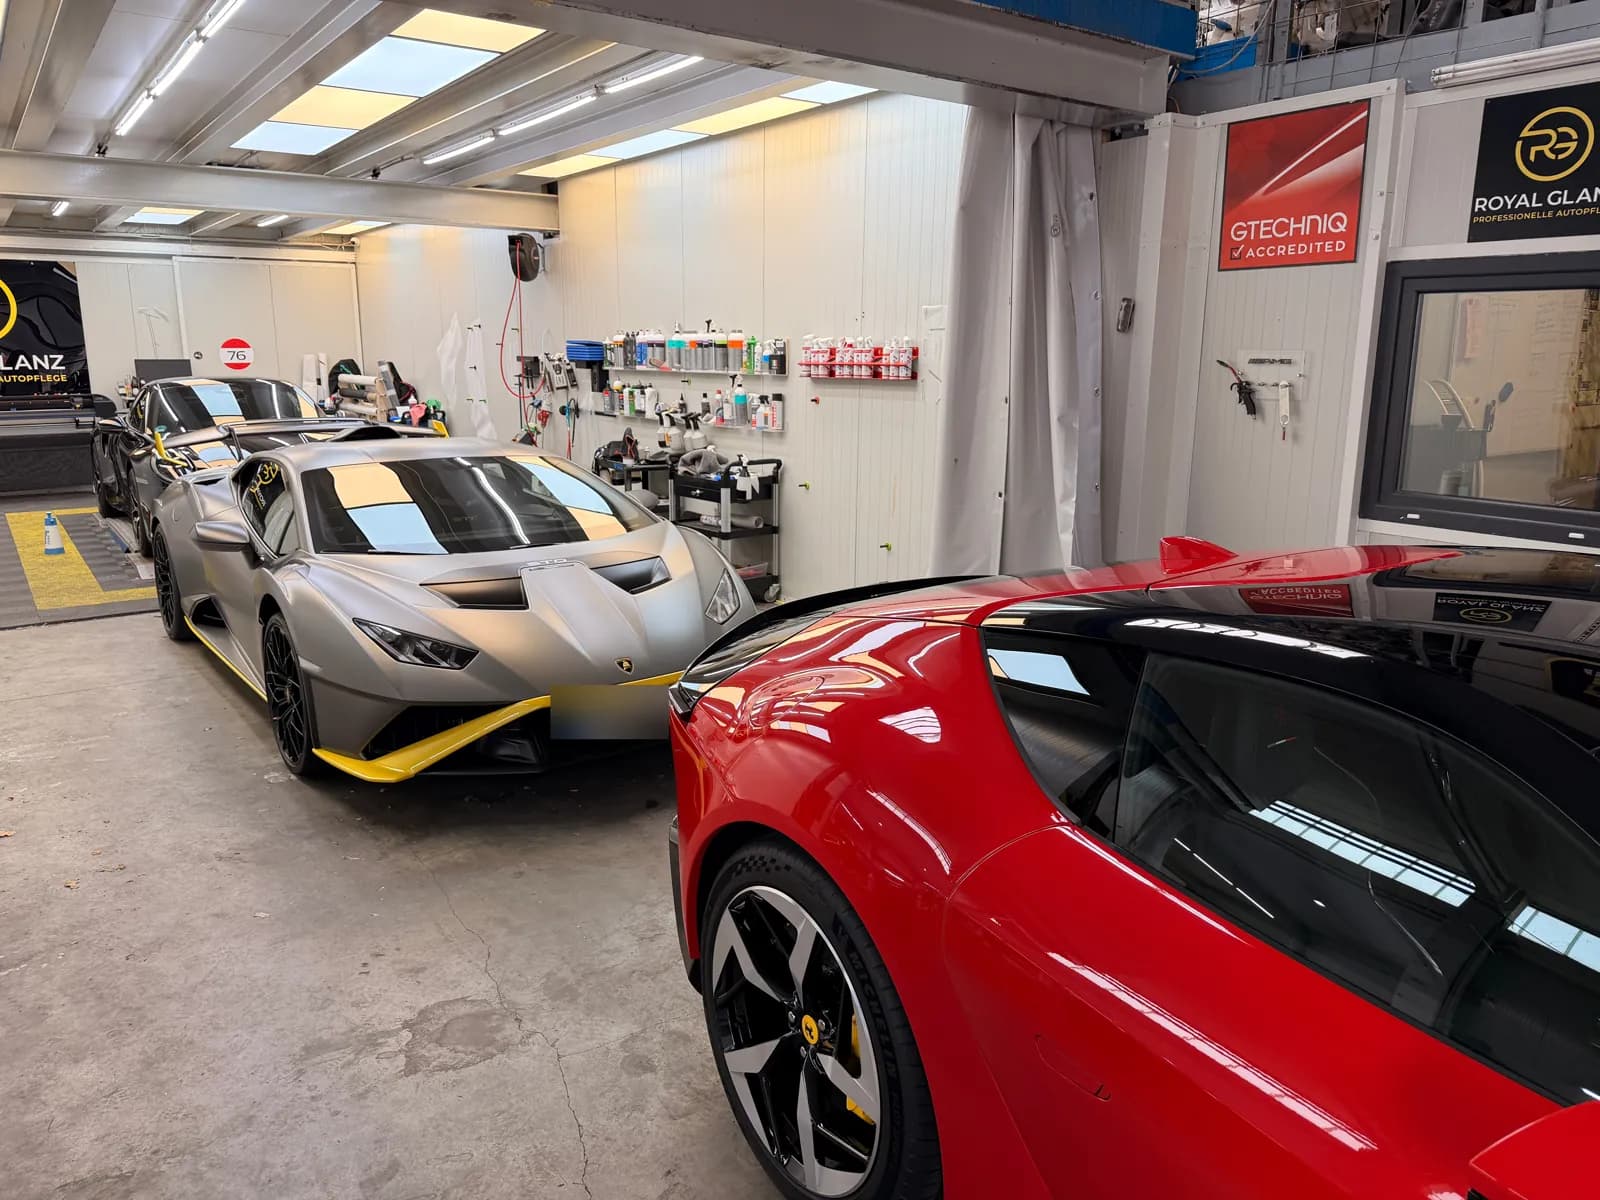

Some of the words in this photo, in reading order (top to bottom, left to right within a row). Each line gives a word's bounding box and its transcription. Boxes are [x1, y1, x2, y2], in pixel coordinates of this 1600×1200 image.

[1474, 192, 1543, 213] ROYAL
[1473, 210, 1554, 224] PROFESSIONELLE
[1230, 211, 1348, 241] GTECHNIQ
[1245, 240, 1346, 258] ACCREDITED
[0, 354, 66, 371] LANZ
[227, 350, 246, 361] 76
